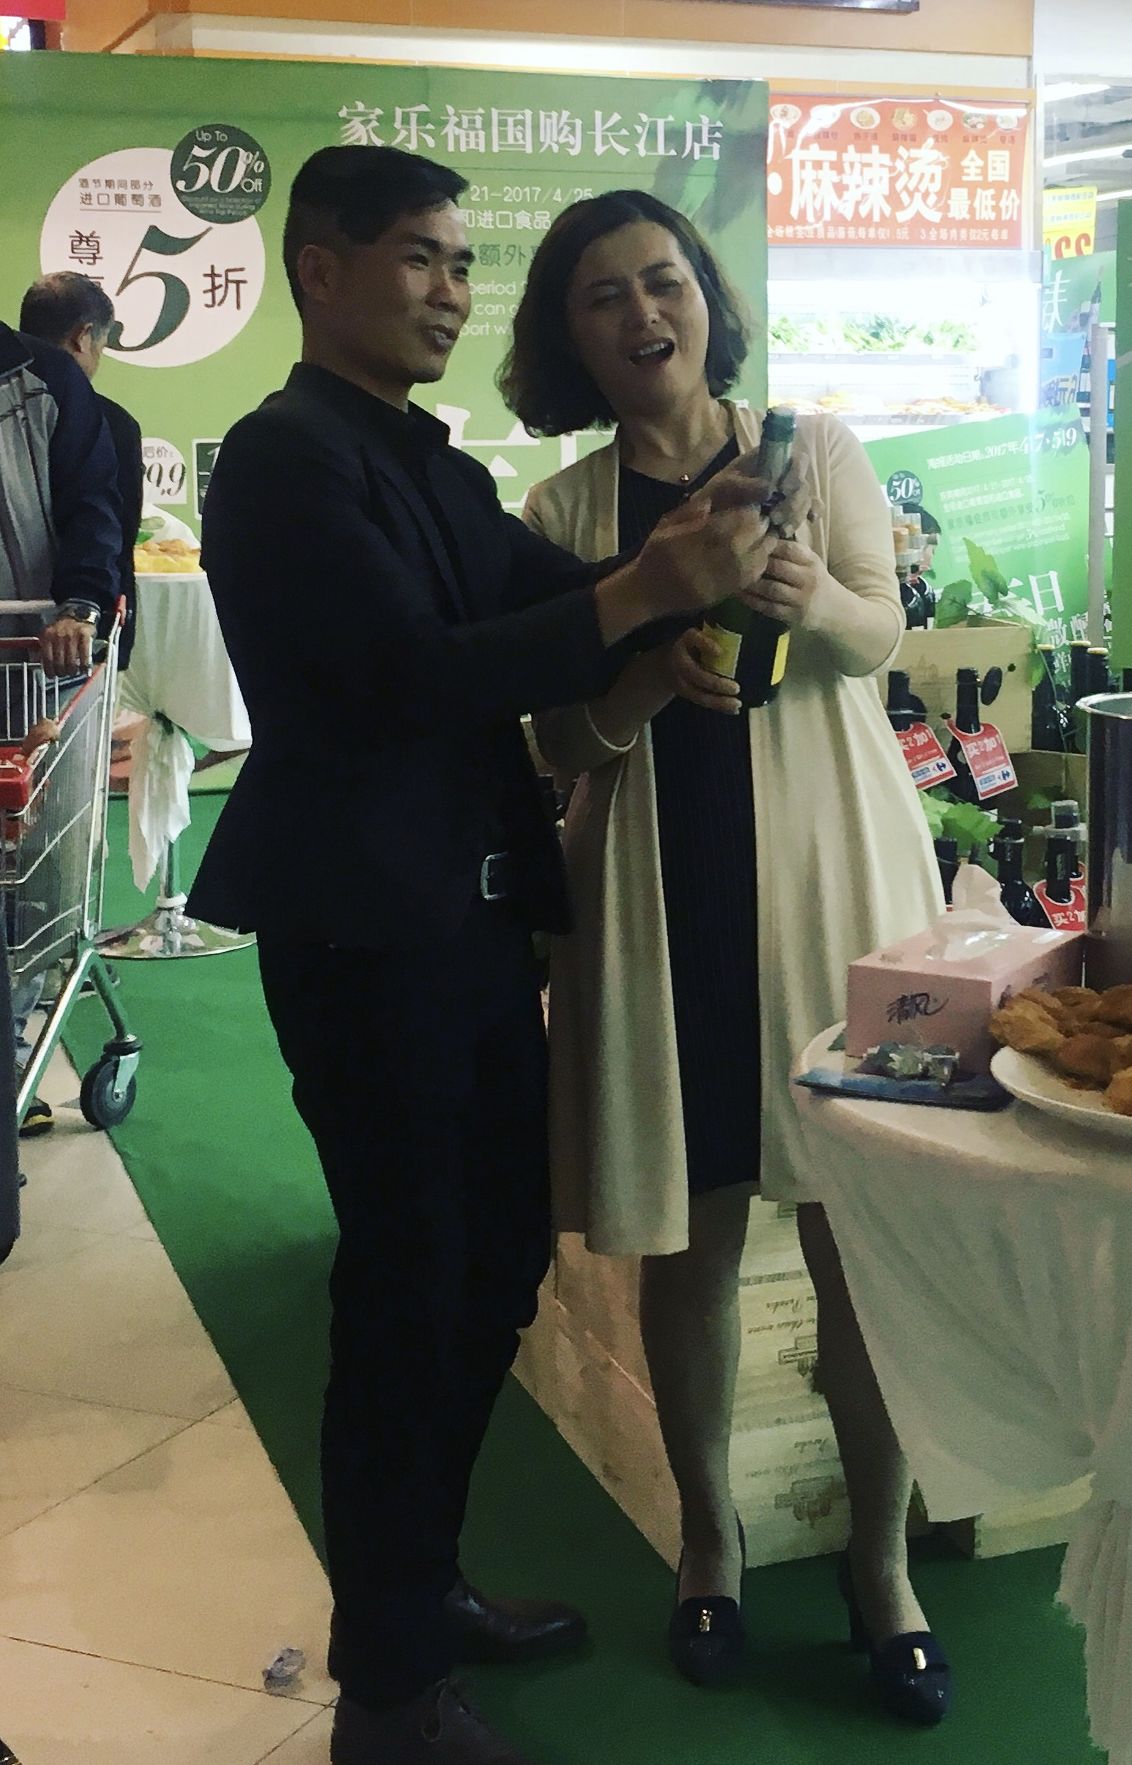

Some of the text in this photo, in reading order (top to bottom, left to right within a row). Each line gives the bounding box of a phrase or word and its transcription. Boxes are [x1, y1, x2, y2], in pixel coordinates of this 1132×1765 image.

[337, 101, 724, 160] 家乐福国购长江店
[176, 145, 265, 193] 50%
[788, 139, 946, 224] 麻辣烫
[960, 149, 1010, 183] 全国
[80, 193, 162, 207] 进口葡萄酒
[947, 187, 1020, 222] 最低价
[107, 225, 213, 352] 5
[203, 264, 248, 310] 折
[474, 304, 506, 315] can
